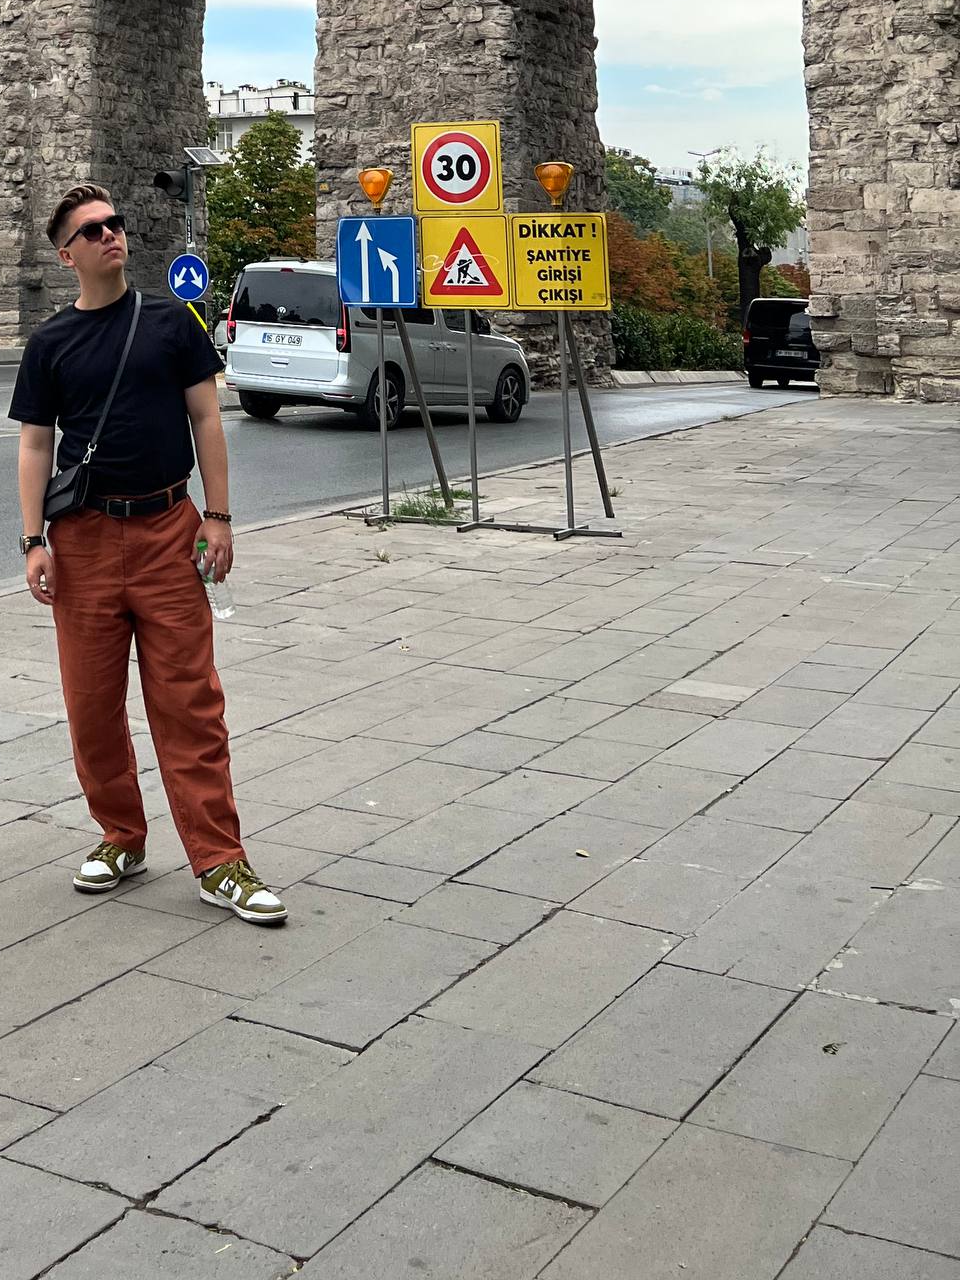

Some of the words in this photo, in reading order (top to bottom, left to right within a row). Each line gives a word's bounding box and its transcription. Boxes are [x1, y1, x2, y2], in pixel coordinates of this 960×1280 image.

[436, 154, 476, 181] 30
[519, 219, 586, 238] DİKKAT
[527, 245, 591, 264] ŞANTİYE
[537, 265, 582, 284] GİRİŞİ
[538, 289, 583, 304] ÇIKIŞI
